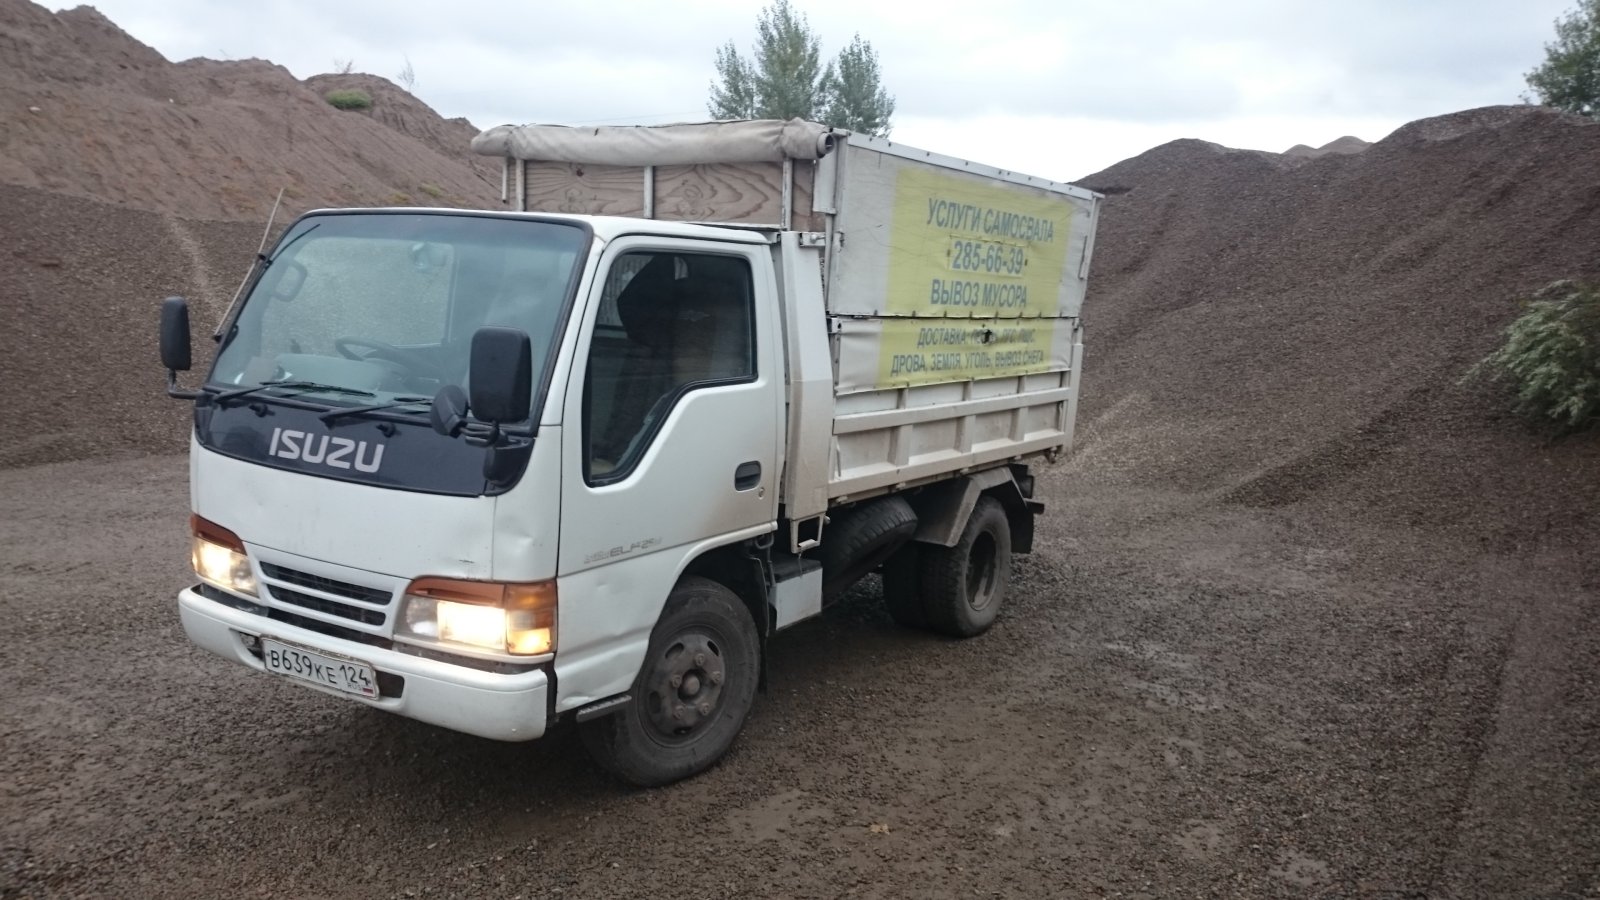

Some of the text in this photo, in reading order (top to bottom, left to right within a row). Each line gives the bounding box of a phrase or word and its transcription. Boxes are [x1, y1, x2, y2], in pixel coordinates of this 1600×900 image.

[927, 198, 1054, 243] УСЛУГИ САМОСВАЛА
[952, 240, 1024, 274] 285-66-39
[930, 279, 1028, 308] ВЫВОЗ МУСОРА
[269, 427, 385, 473] ISUZU
